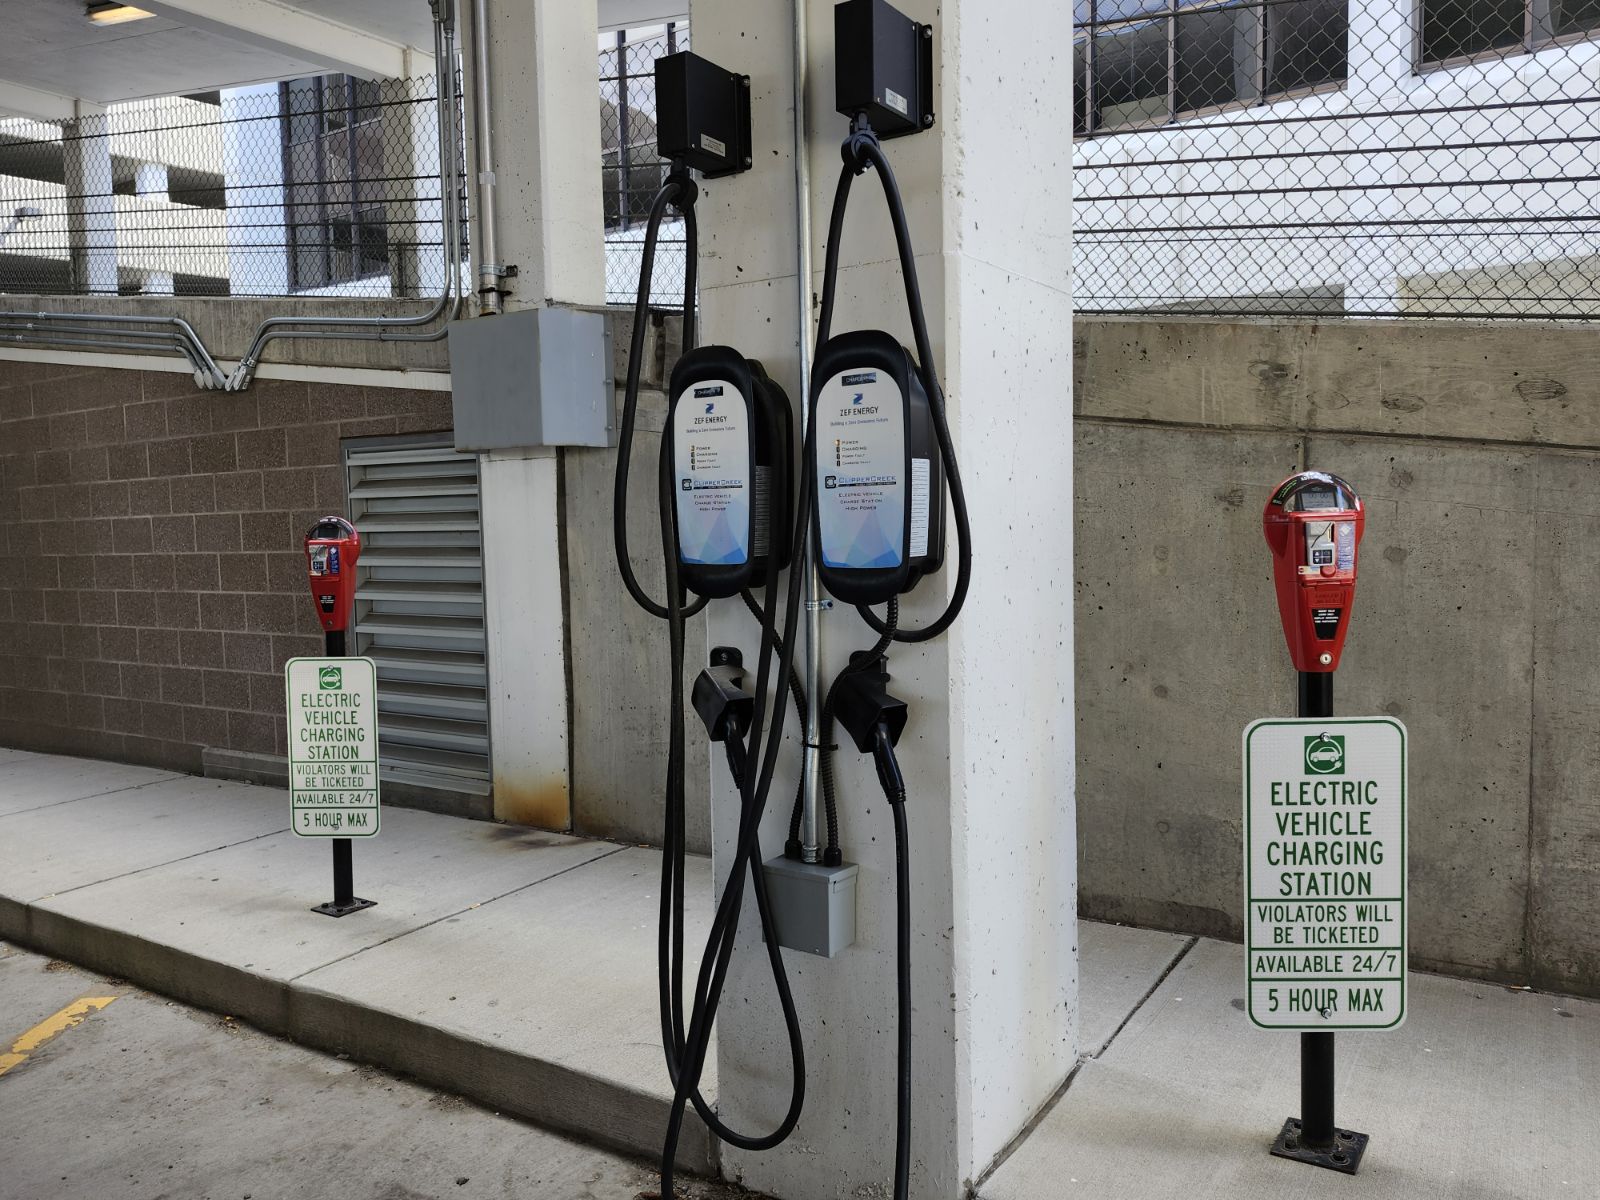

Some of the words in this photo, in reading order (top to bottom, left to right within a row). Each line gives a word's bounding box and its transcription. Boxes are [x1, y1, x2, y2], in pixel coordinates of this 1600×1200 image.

[840, 408, 853, 417] ZEF
[853, 406, 879, 416] ENERGY
[694, 417, 705, 425] ZEF
[705, 415, 728, 424] ENERGY
[301, 693, 361, 708] ELECTRIC
[304, 710, 358, 725] VEHICLE
[300, 727, 366, 742] CHARGING
[307, 745, 360, 760] STATION
[296, 764, 346, 775] VIOLATORS
[349, 764, 372, 774] WILL
[305, 776, 318, 788] BE
[322, 776, 364, 788] TICKETED
[295, 792, 347, 804] AVAILABLE
[348, 790, 375, 804] 24/7
[1271, 781, 1378, 806] ELECTRIC
[303, 813, 311, 828] 5
[314, 812, 343, 828] HOUR
[346, 812, 368, 827] MAX
[1275, 811, 1372, 836] VEHICLE
[1266, 840, 1384, 866] CHARGING
[1279, 871, 1372, 896] STATION
[1257, 905, 1347, 923] VIOLATORS
[1355, 905, 1393, 923] WILL
[1273, 926, 1294, 944] BE
[1302, 926, 1379, 944] TICKETED
[1255, 954, 1344, 973] AVAILABLE
[1352, 950, 1397, 973] 24/7
[1268, 988, 1279, 1013] 5
[1288, 988, 1338, 1013] HOUR
[1348, 988, 1384, 1013] MAX
